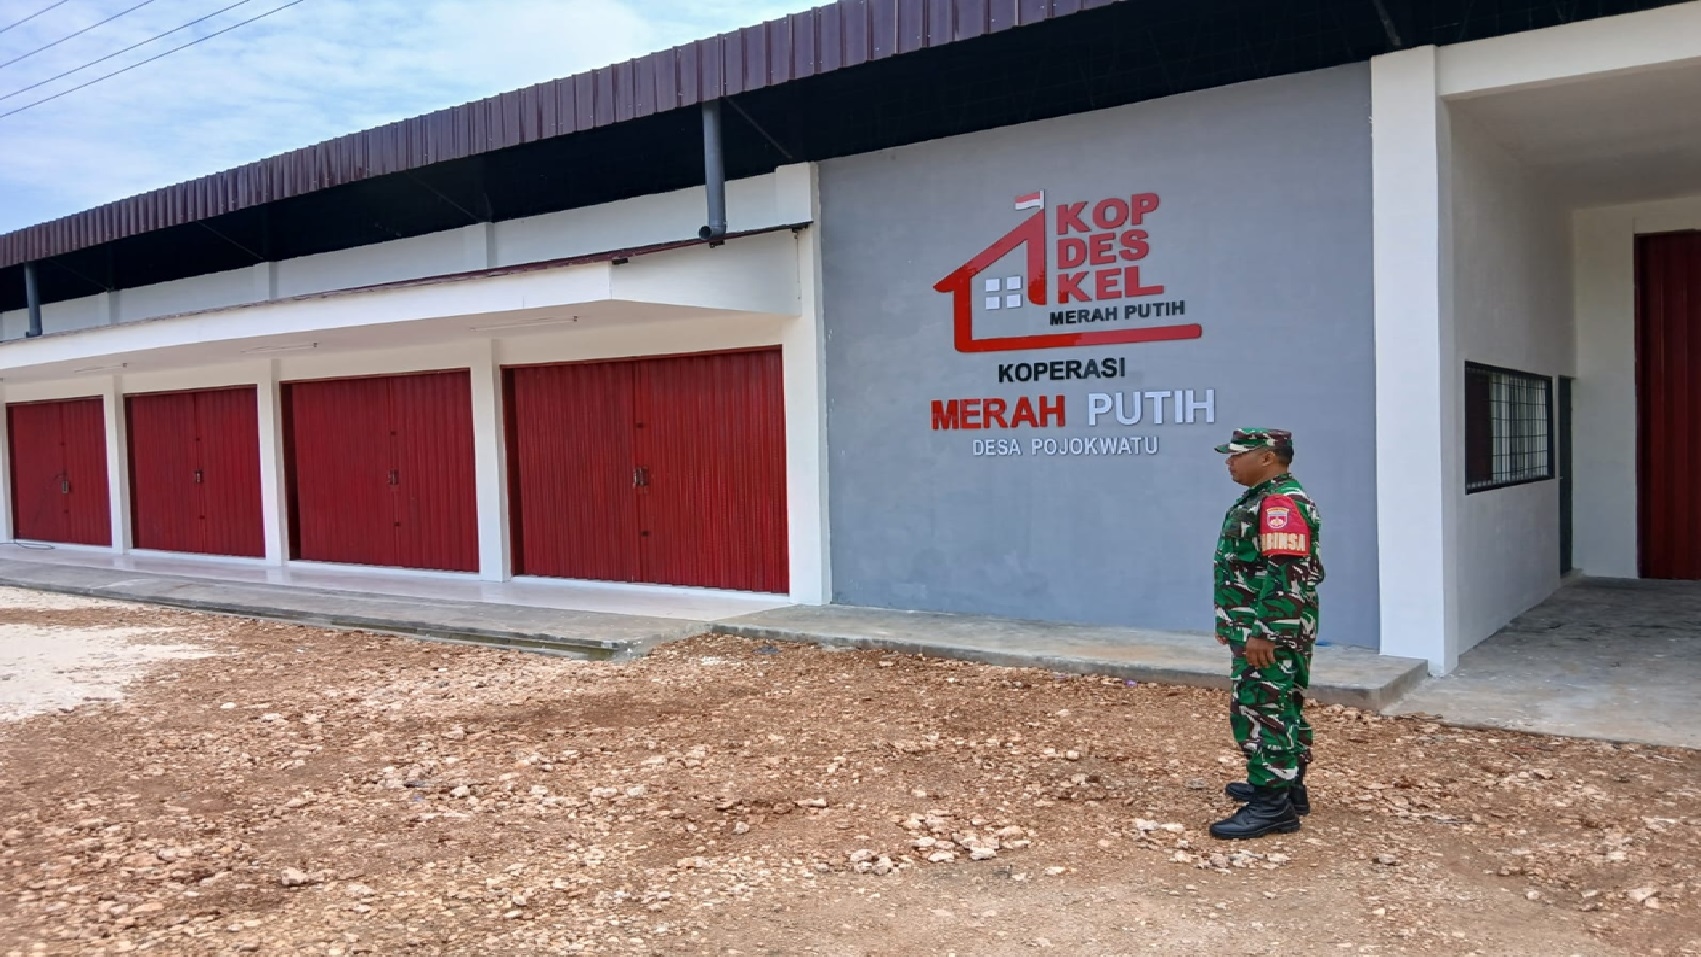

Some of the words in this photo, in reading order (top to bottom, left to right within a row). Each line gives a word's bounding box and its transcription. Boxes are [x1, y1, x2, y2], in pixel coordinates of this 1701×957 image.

[1056, 193, 1159, 235] KOP
[1057, 229, 1149, 269] DES
[1057, 265, 1164, 304] KEL
[1050, 309, 1117, 326] MERAH
[1124, 300, 1185, 320] PUTIH
[998, 357, 1125, 382] KOPERASI
[930, 395, 1065, 430] MERAH
[1088, 389, 1215, 426] PUTIH
[972, 438, 1022, 456] DESA
[1031, 437, 1159, 455] POJOKWATU
